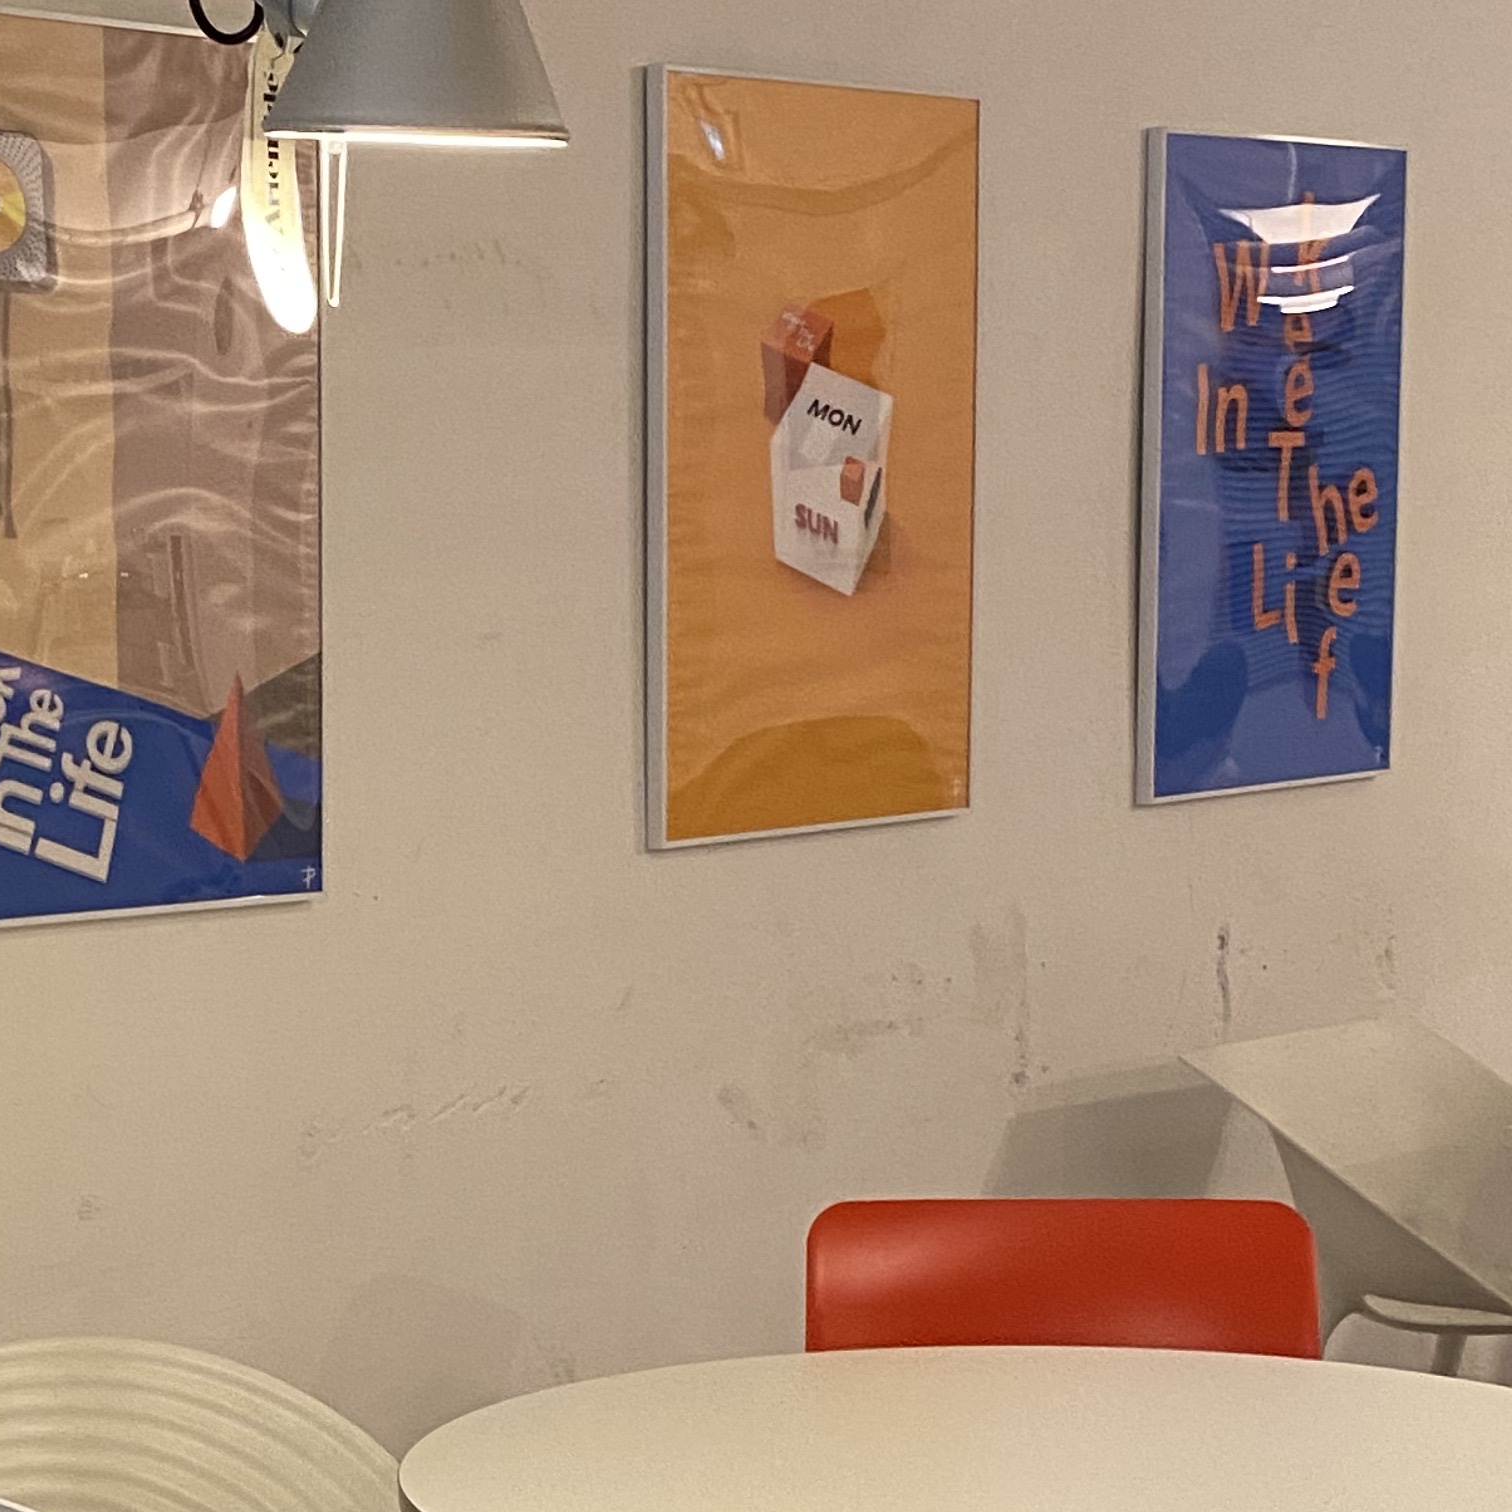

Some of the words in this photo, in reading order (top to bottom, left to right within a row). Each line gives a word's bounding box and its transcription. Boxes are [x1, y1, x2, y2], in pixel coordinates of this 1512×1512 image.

[806, 399, 862, 436] MON
[1196, 363, 1248, 456] In
[1268, 431, 1379, 556] The
[794, 503, 838, 544] SUN
[35, 720, 133, 883] Life
